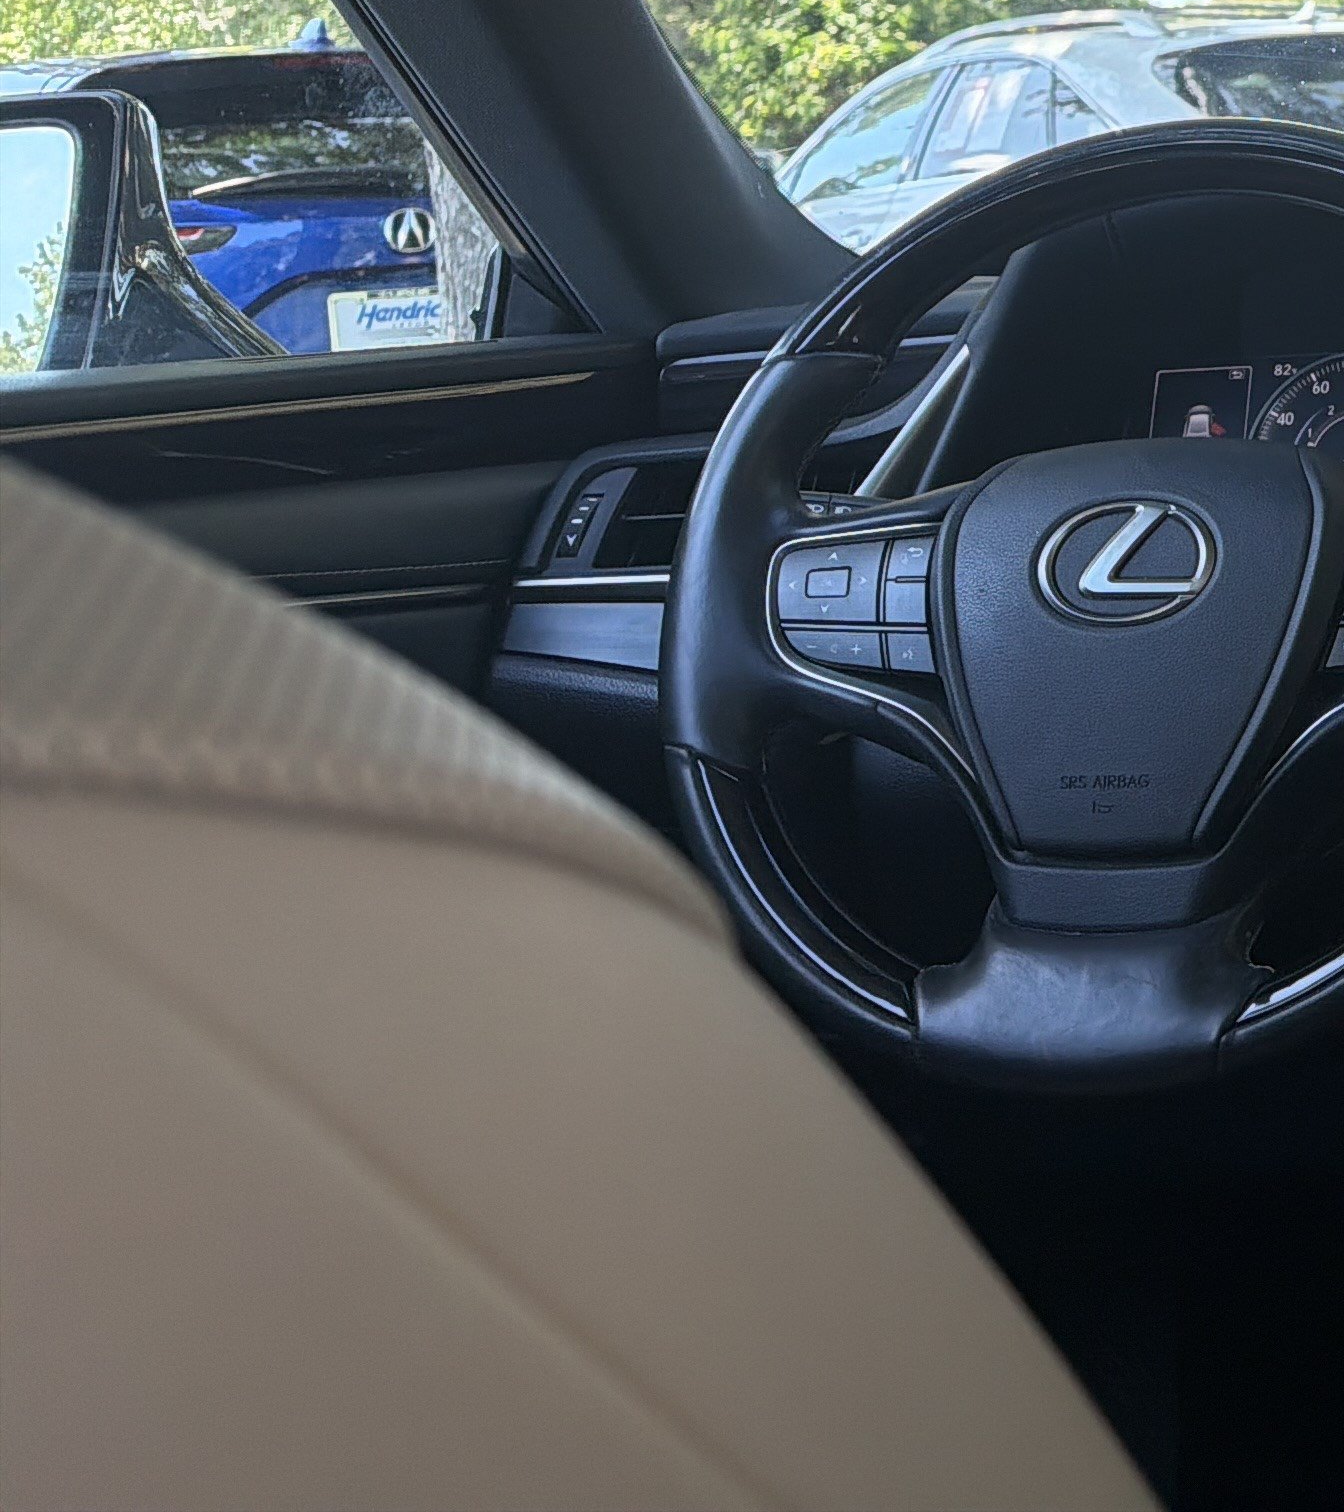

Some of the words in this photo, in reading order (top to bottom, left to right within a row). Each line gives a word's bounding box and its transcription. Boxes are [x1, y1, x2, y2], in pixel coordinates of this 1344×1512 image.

[356, 299, 443, 331] Hendric
[1312, 381, 1331, 395] 60
[1326, 405, 1335, 416] 2
[1276, 412, 1295, 426] 40
[1059, 774, 1088, 790] SRS
[1092, 773, 1151, 791] AIRBAG
